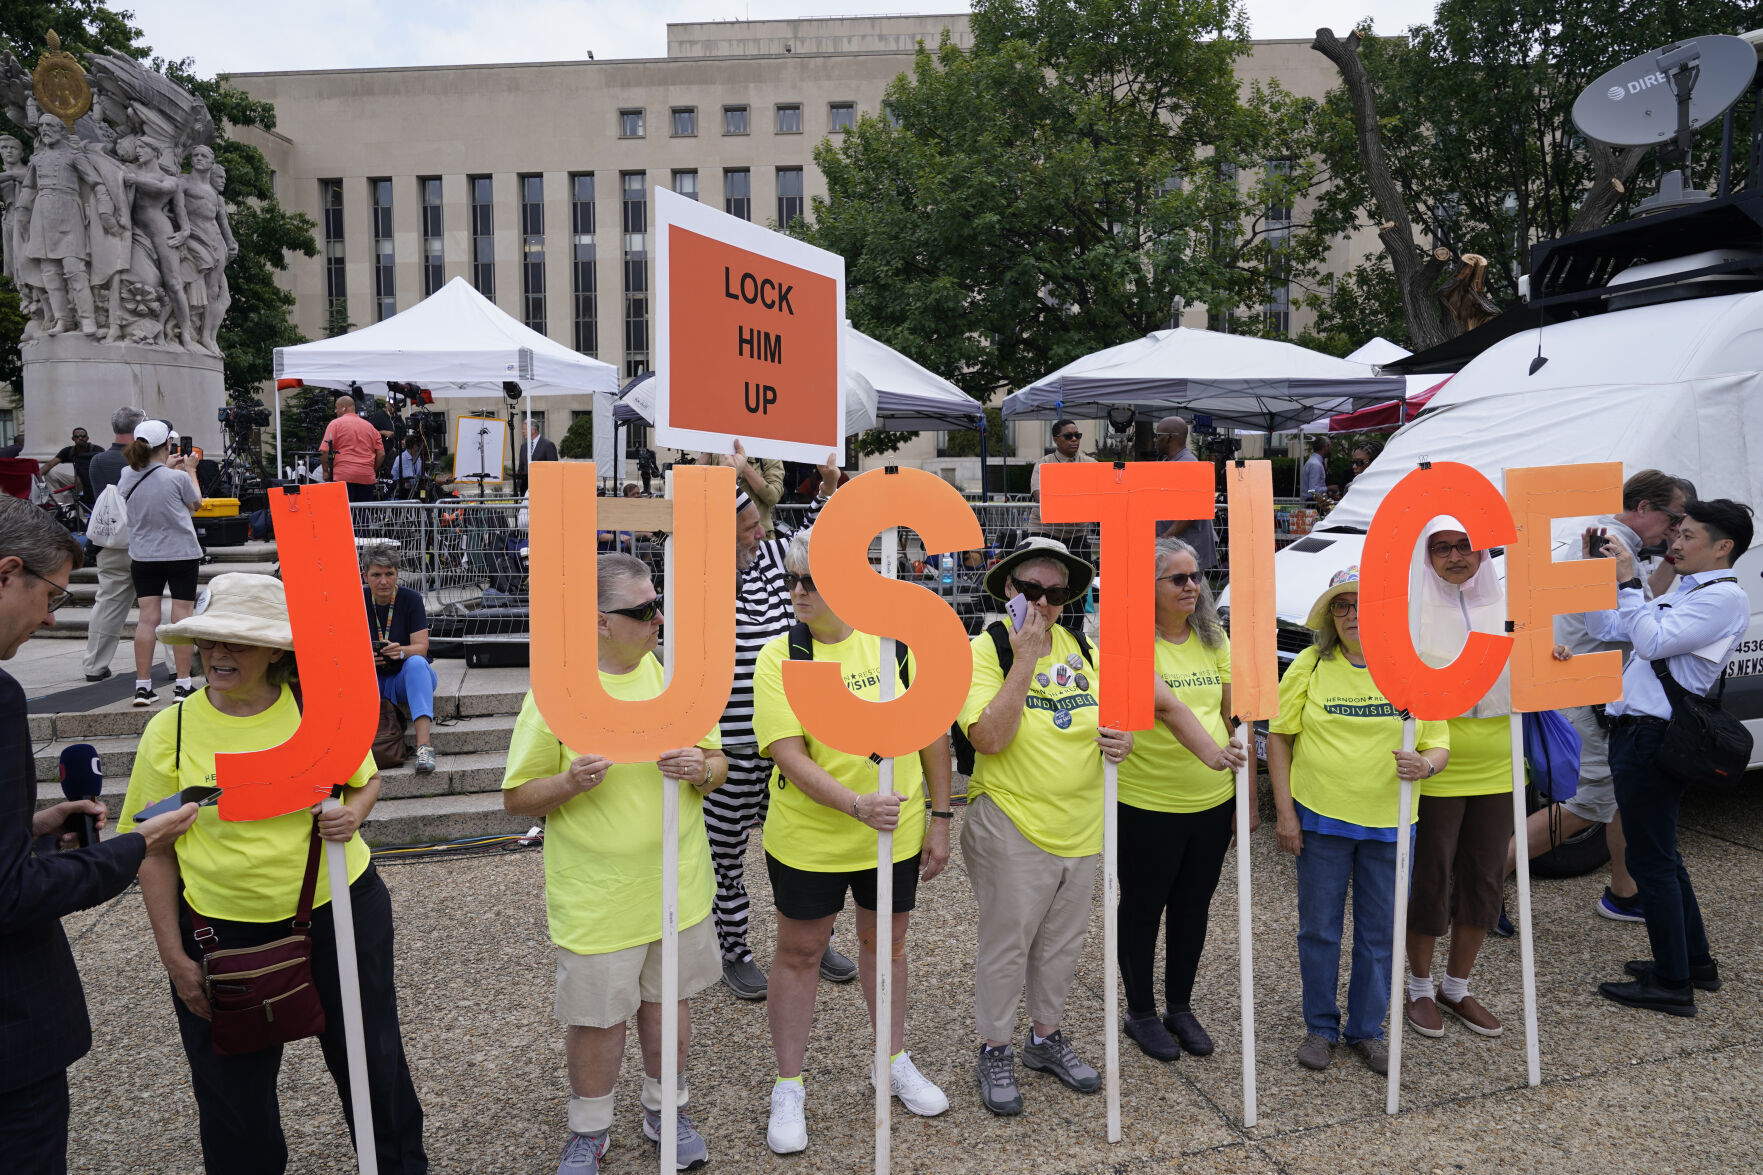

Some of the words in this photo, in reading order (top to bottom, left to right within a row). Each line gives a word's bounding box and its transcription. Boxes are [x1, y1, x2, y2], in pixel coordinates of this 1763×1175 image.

[1627, 71, 1667, 95] DIRE
[724, 266, 794, 315] LOCK
[738, 325, 782, 364] HIM
[744, 381, 777, 415] UP
[1165, 676, 1221, 688] NDIVISIBLE
[1028, 695, 1094, 710] INDIVISIBLE
[1326, 696, 1367, 704] HERNDON
[1326, 705, 1400, 715] INDIVISIBL
